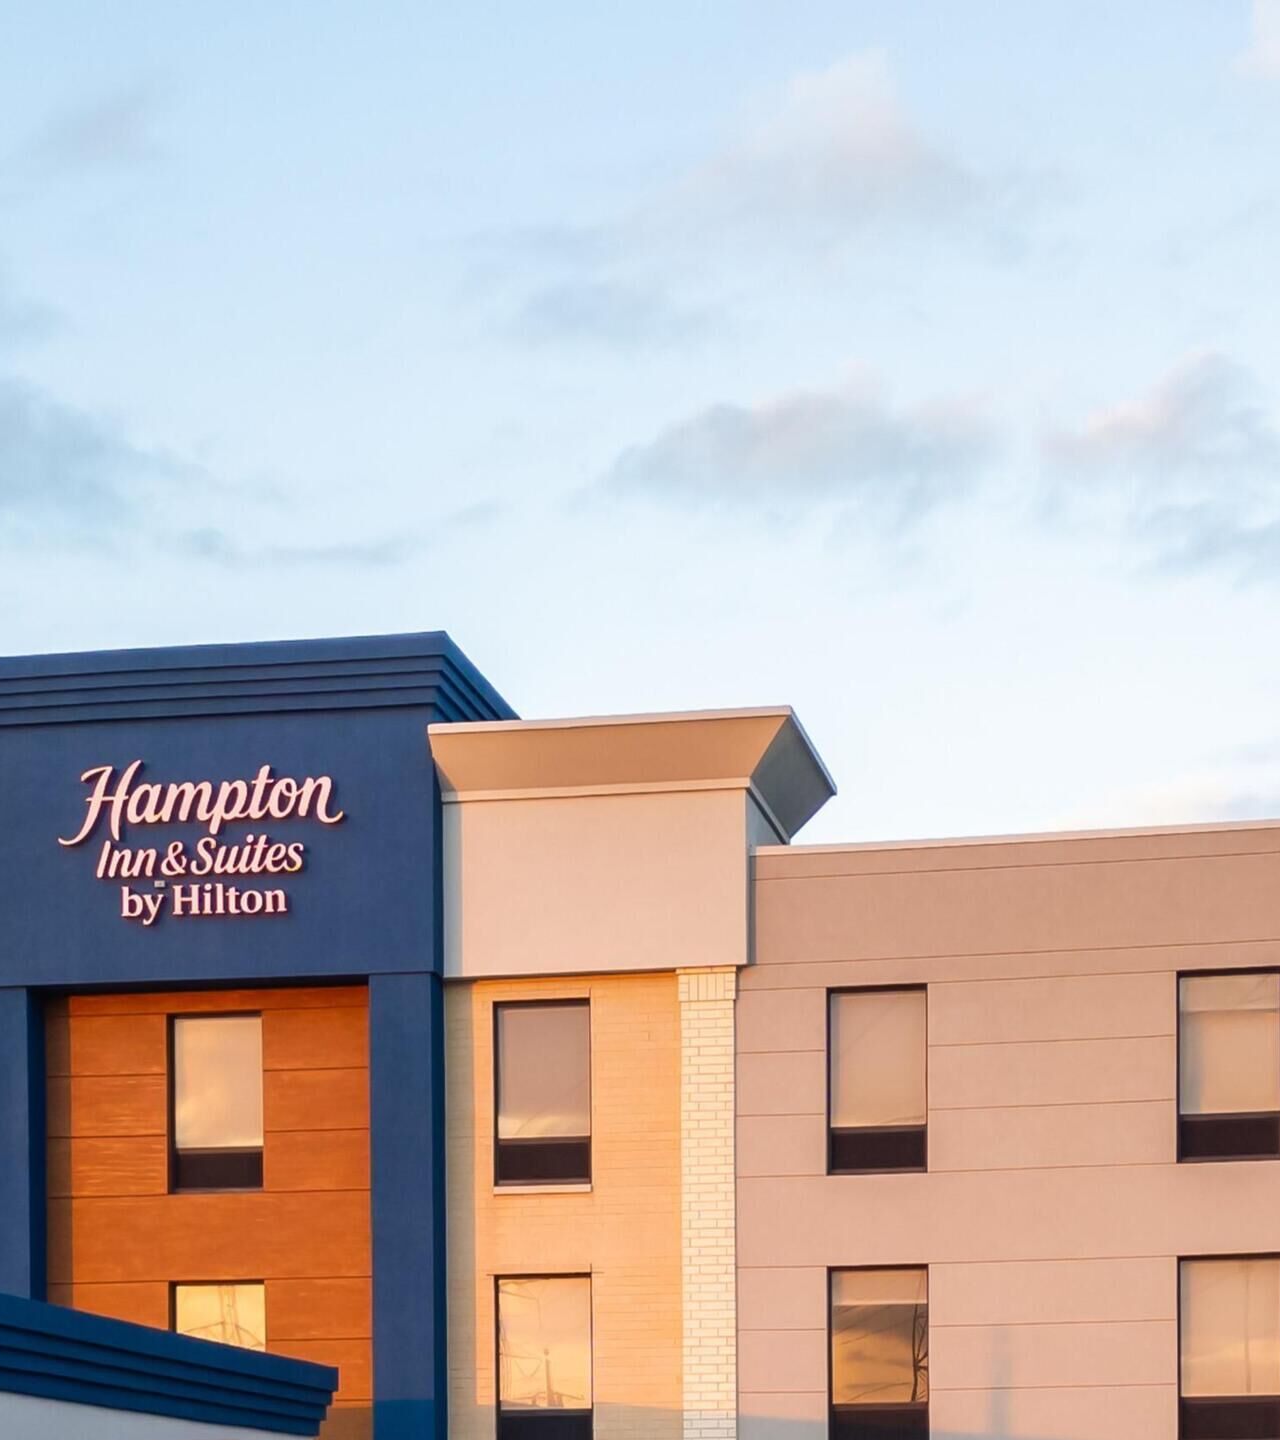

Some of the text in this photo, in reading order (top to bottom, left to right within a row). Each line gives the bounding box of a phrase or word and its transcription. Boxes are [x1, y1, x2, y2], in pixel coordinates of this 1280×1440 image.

[58, 760, 344, 845] Hampton
[96, 834, 304, 878] Inn & Suites
[121, 883, 287, 926] by Hilton
